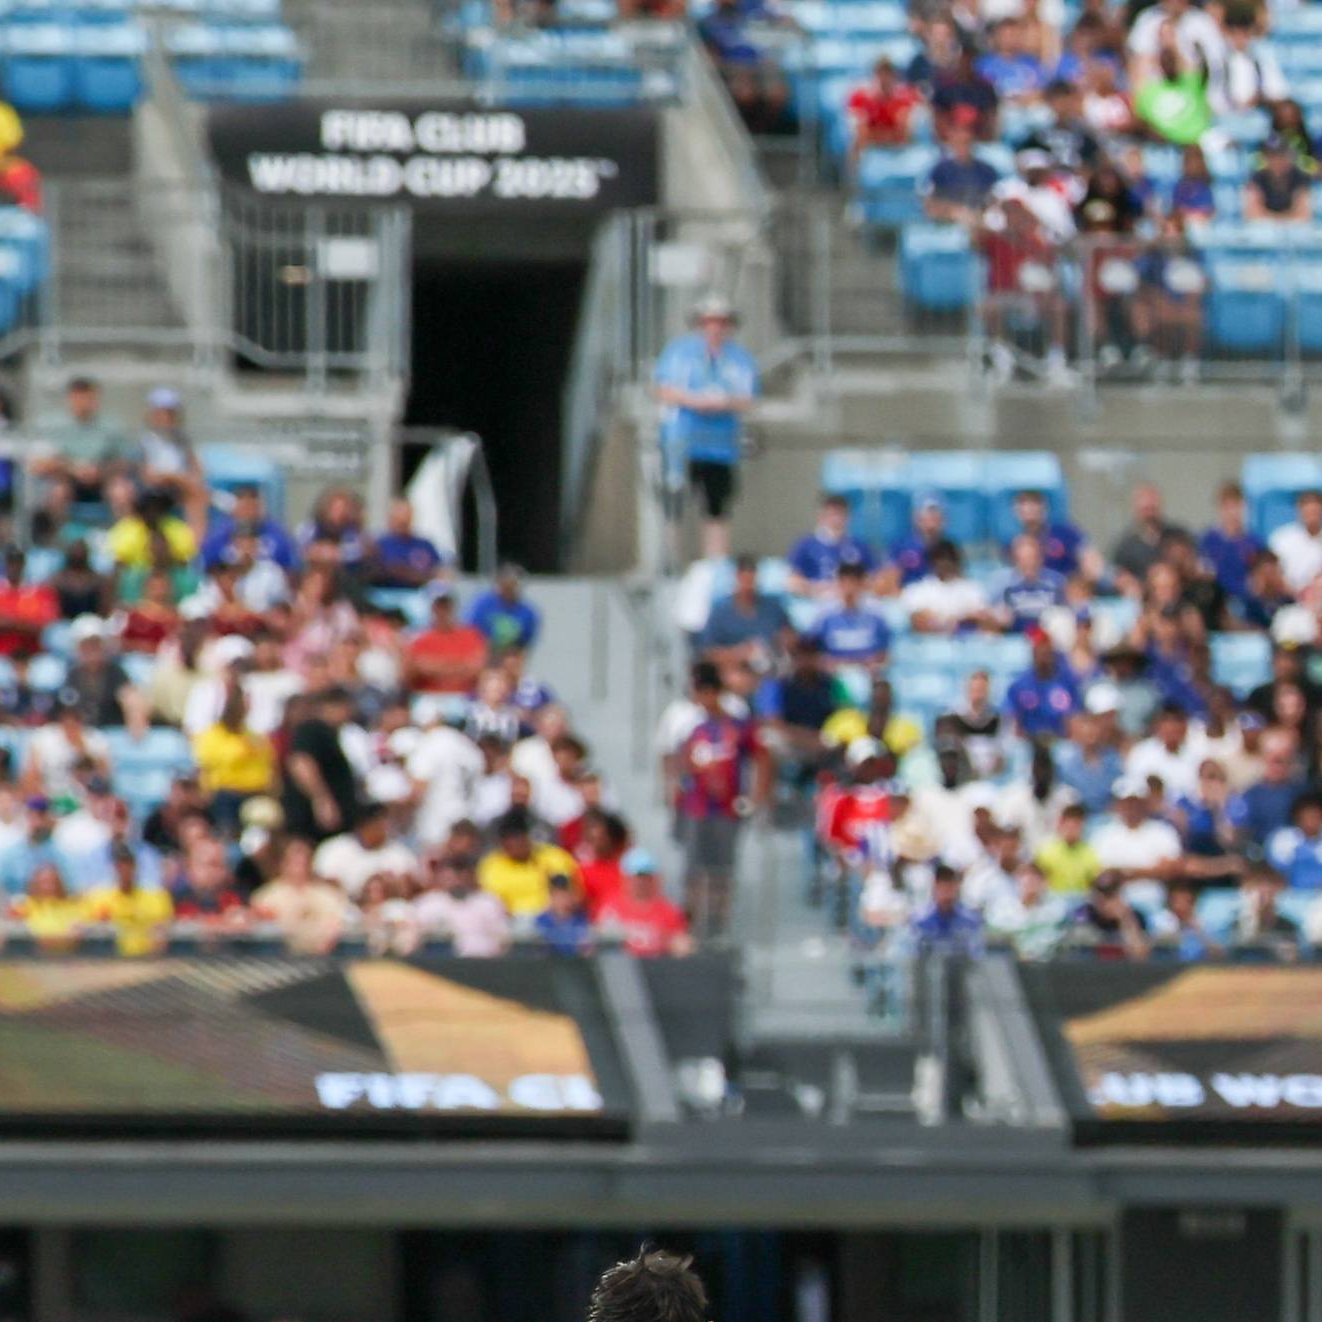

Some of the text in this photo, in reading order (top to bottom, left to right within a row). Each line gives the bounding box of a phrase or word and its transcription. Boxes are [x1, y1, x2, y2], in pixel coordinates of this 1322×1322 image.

[321, 111, 526, 154] FIFA CLUB
[248, 155, 403, 195] WORLD
[404, 157, 491, 197] CUP
[315, 1072, 500, 1110] FIFA
[1086, 1072, 1204, 1107] UB
